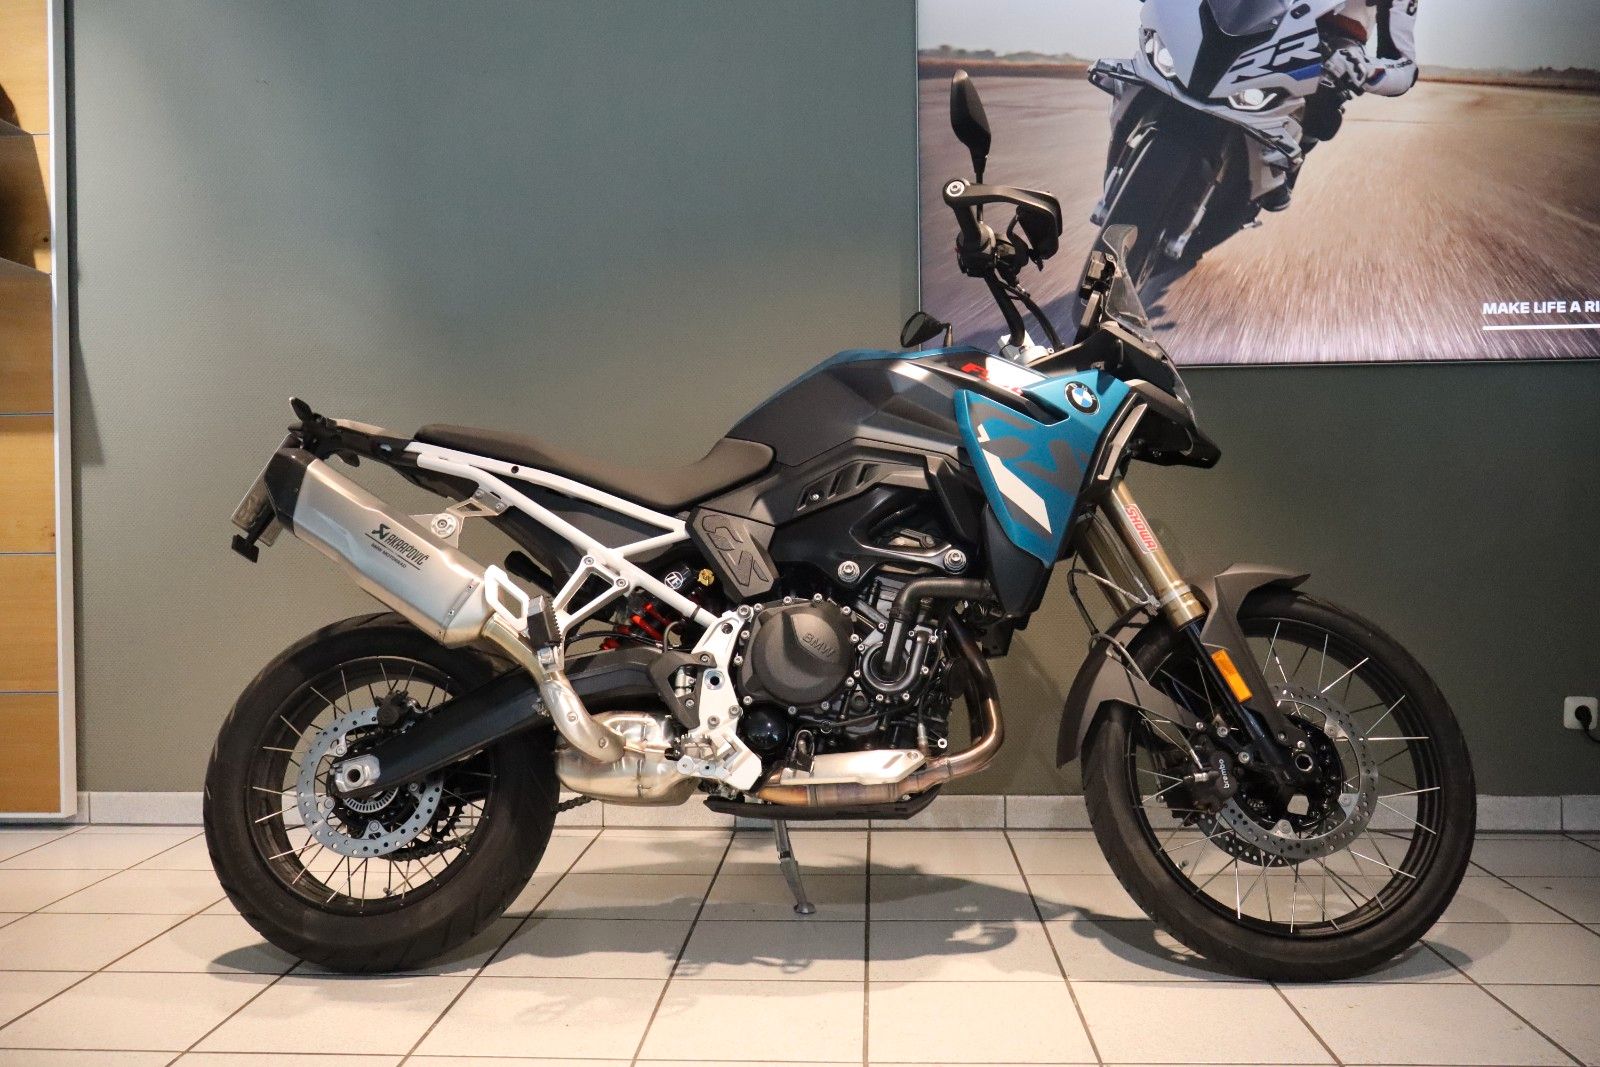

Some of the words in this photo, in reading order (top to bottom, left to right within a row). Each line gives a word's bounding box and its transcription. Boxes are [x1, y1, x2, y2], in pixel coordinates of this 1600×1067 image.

[1482, 301, 1530, 315] MAKE
[1533, 301, 1567, 314] LIFE
[1569, 301, 1582, 313] A
[1125, 505, 1157, 549] SHOWA
[802, 632, 836, 658] BMW
[1219, 758, 1230, 789] brembo
